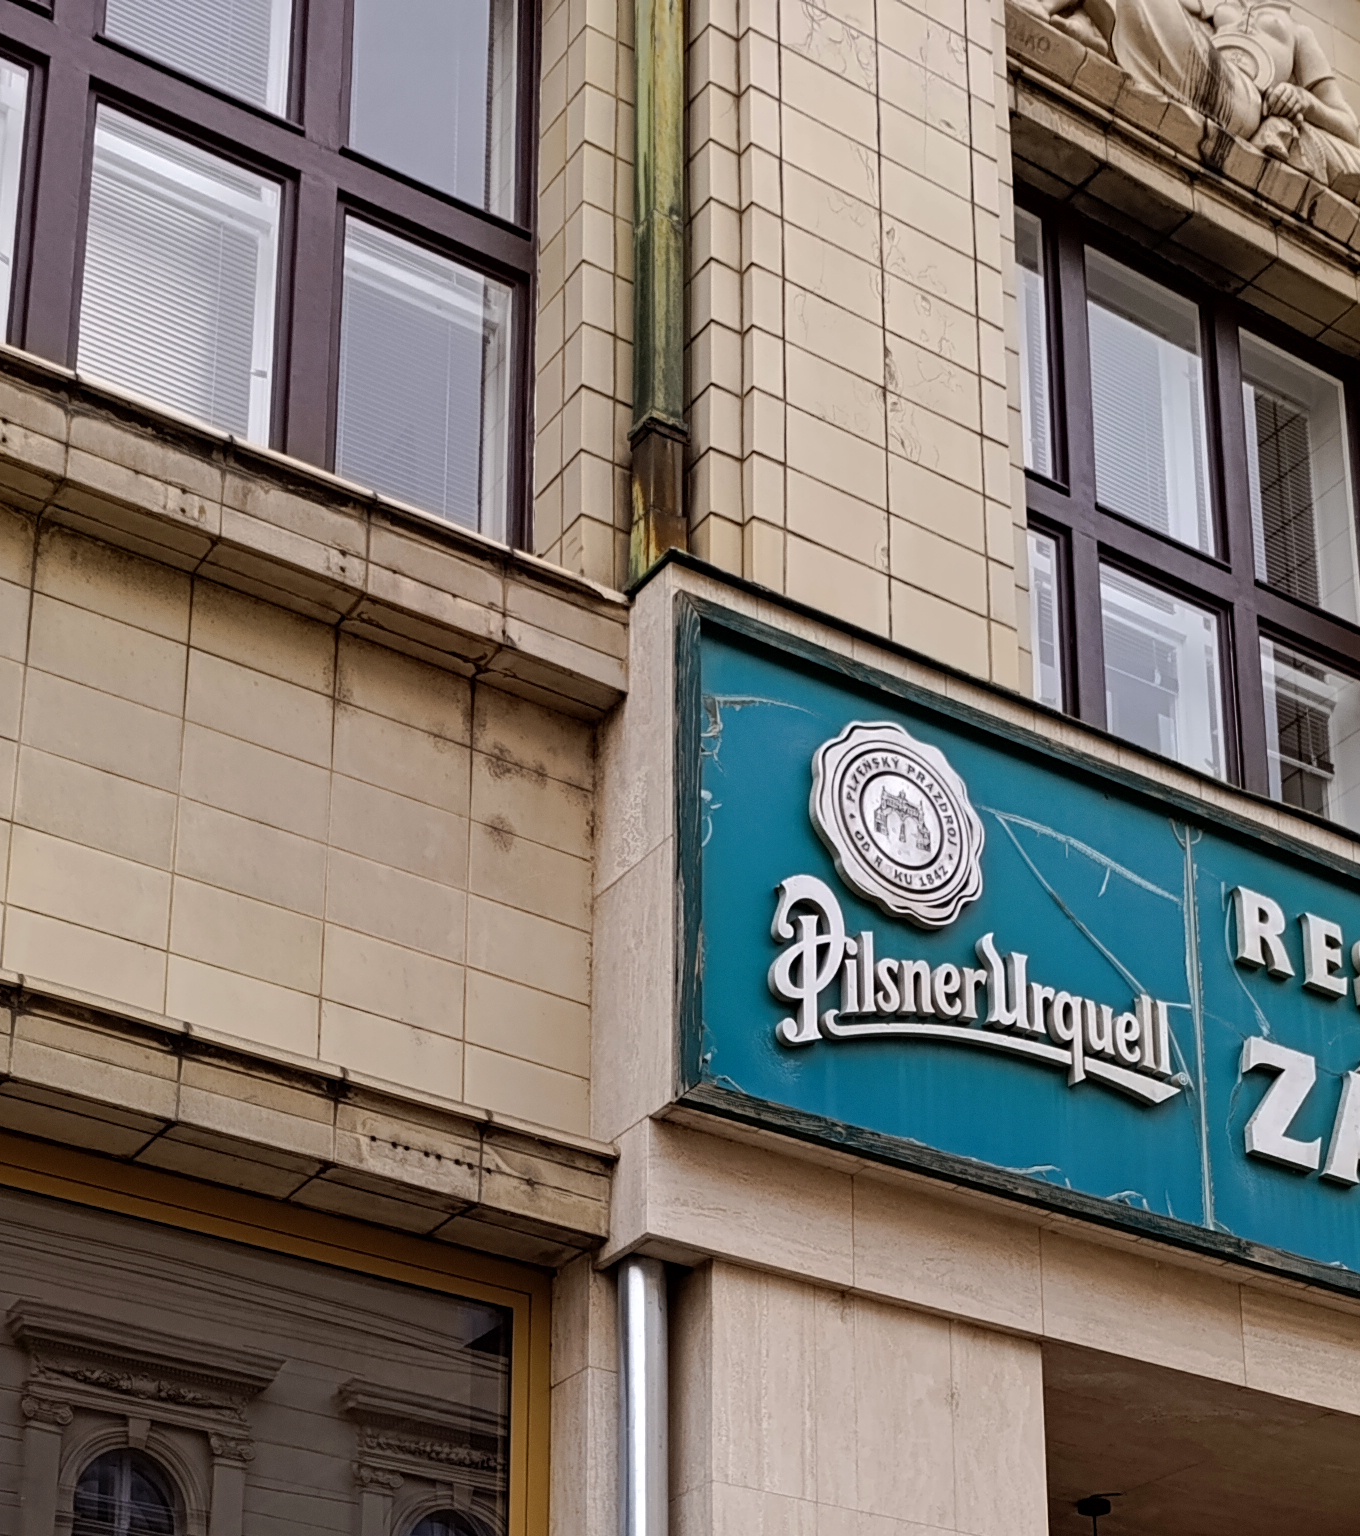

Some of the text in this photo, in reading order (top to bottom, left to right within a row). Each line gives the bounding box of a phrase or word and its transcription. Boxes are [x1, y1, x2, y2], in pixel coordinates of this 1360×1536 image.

[907, 764, 958, 846] PRAZDROJ
[854, 830, 949, 887] OD RKU 1842
[768, 875, 1172, 1086] Pilsner Urquell
